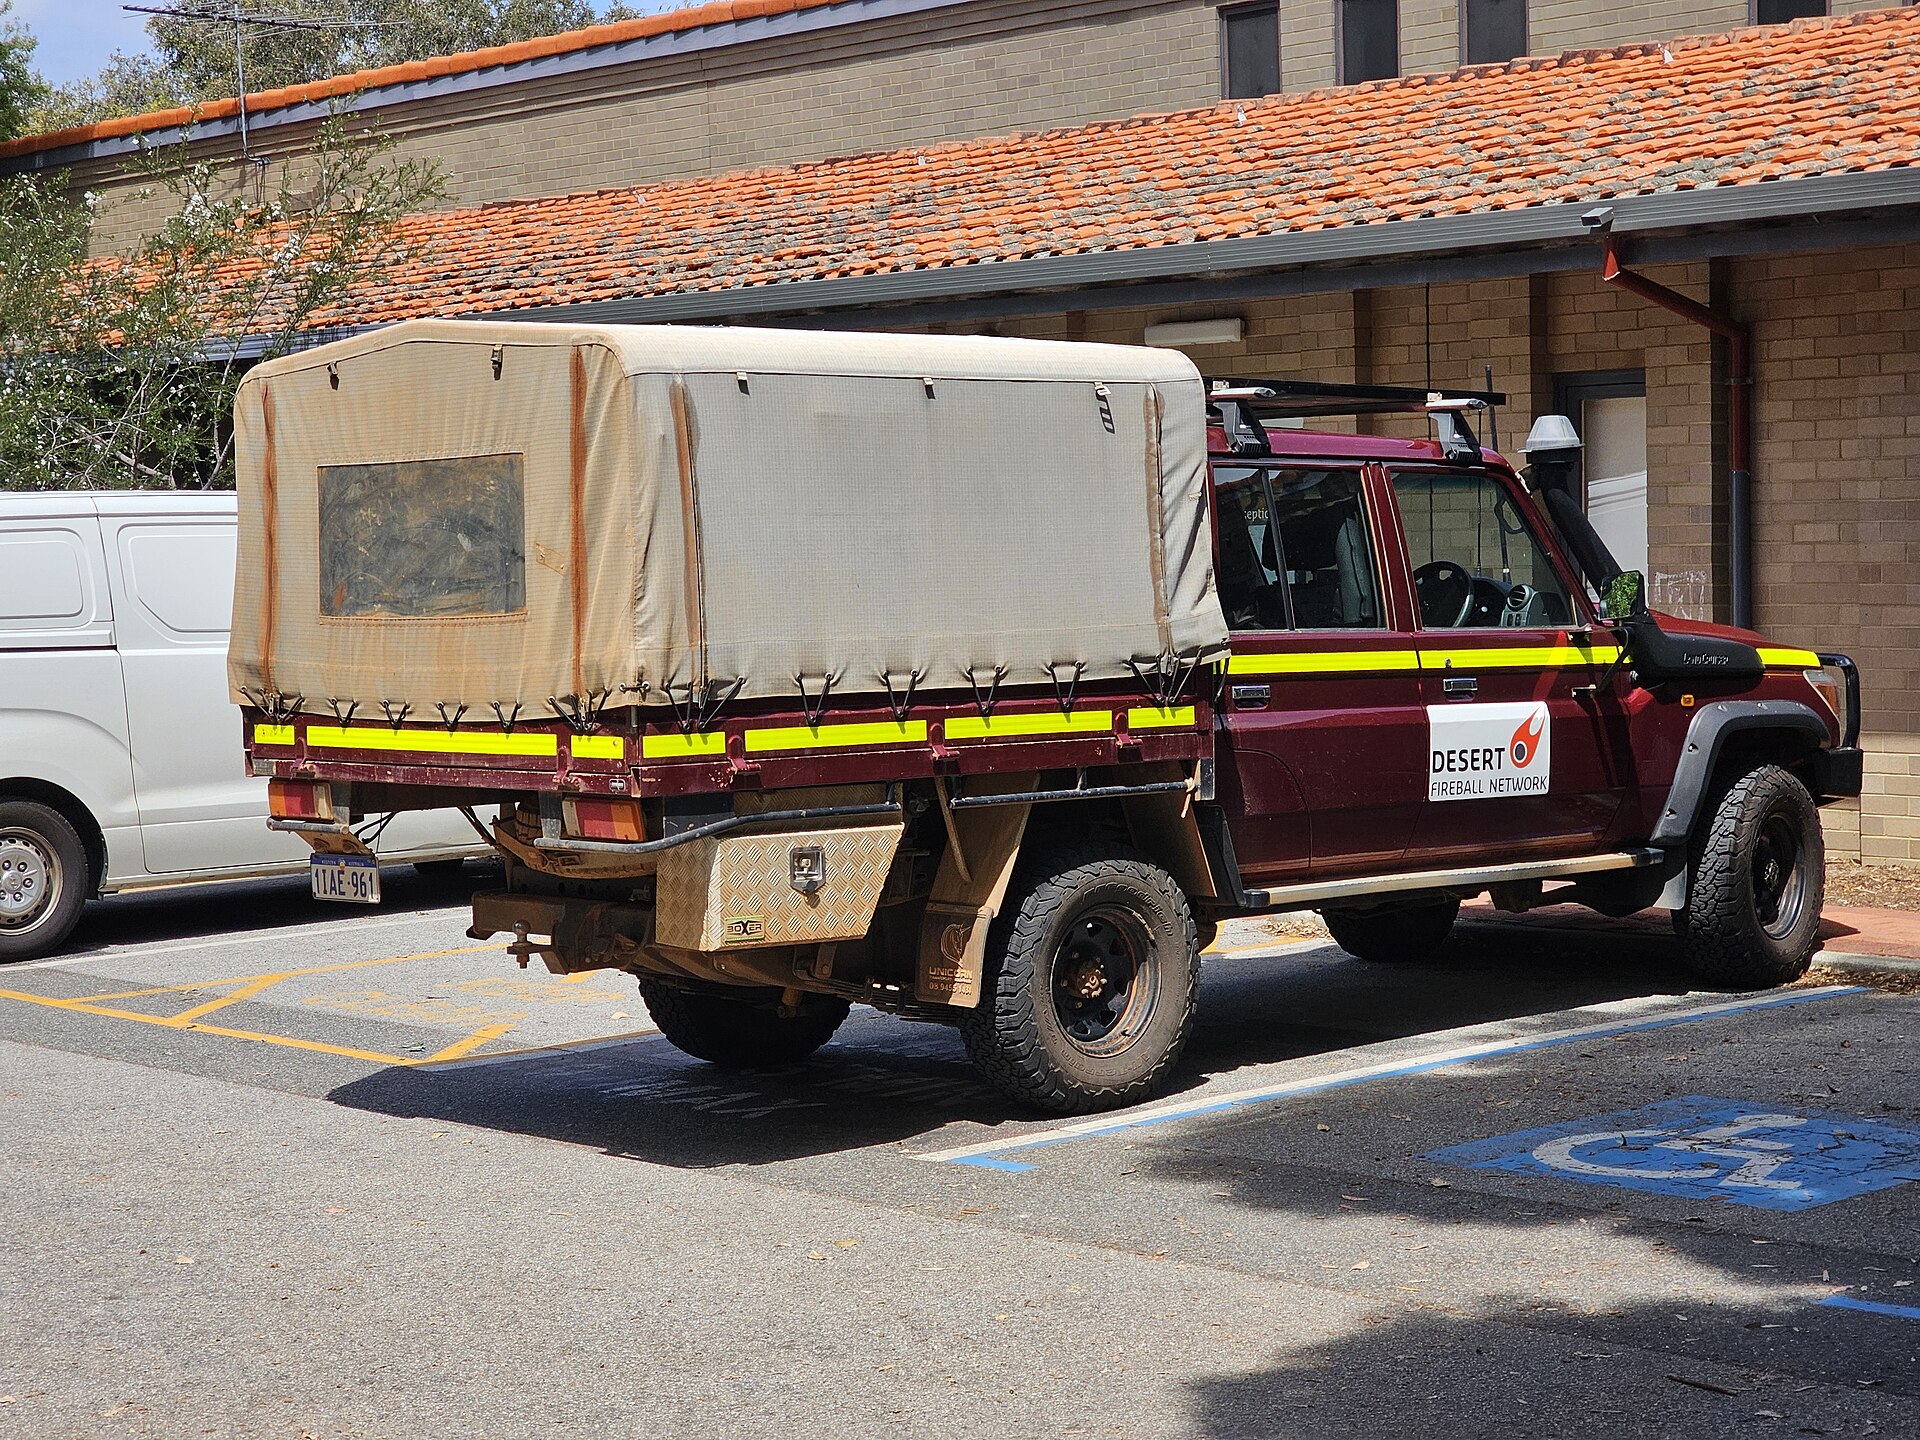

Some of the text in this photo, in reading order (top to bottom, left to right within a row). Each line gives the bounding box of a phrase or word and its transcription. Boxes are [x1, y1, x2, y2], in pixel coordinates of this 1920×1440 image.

[1432, 747, 1505, 774] DESERT
[1431, 775, 1547, 797] FIREBALL NETWORK
[929, 966, 973, 980] UNICORN
